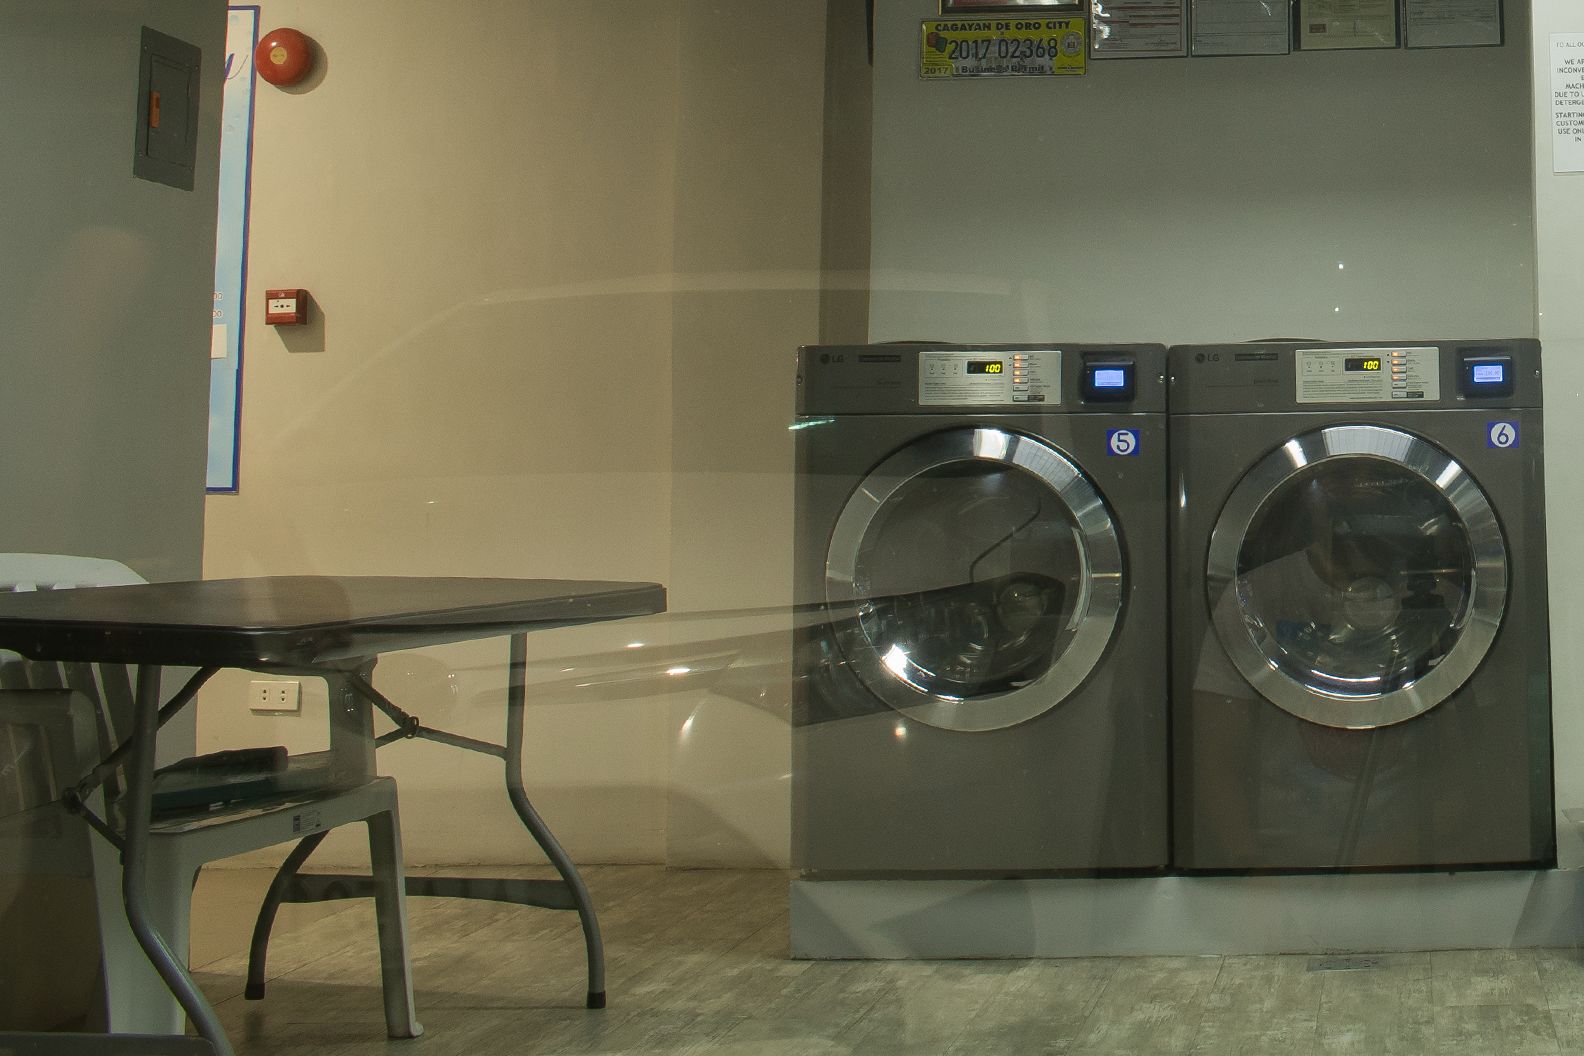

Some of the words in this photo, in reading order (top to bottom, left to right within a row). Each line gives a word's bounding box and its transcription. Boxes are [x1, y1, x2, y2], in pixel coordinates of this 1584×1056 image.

[935, 23, 992, 32] CAGAYAN
[996, 22, 1011, 31] DE
[1015, 22, 1041, 31] ORO
[1045, 21, 1072, 30] CITY
[948, 39, 991, 60] 2017
[998, 38, 1058, 59] 02368
[923, 66, 948, 75] 2017
[1207, 353, 1220, 362] LG
[984, 363, 1002, 373] 100
[1363, 360, 1380, 370] 100
[1496, 425, 1510, 445] 6
[1116, 432, 1131, 453] 5
